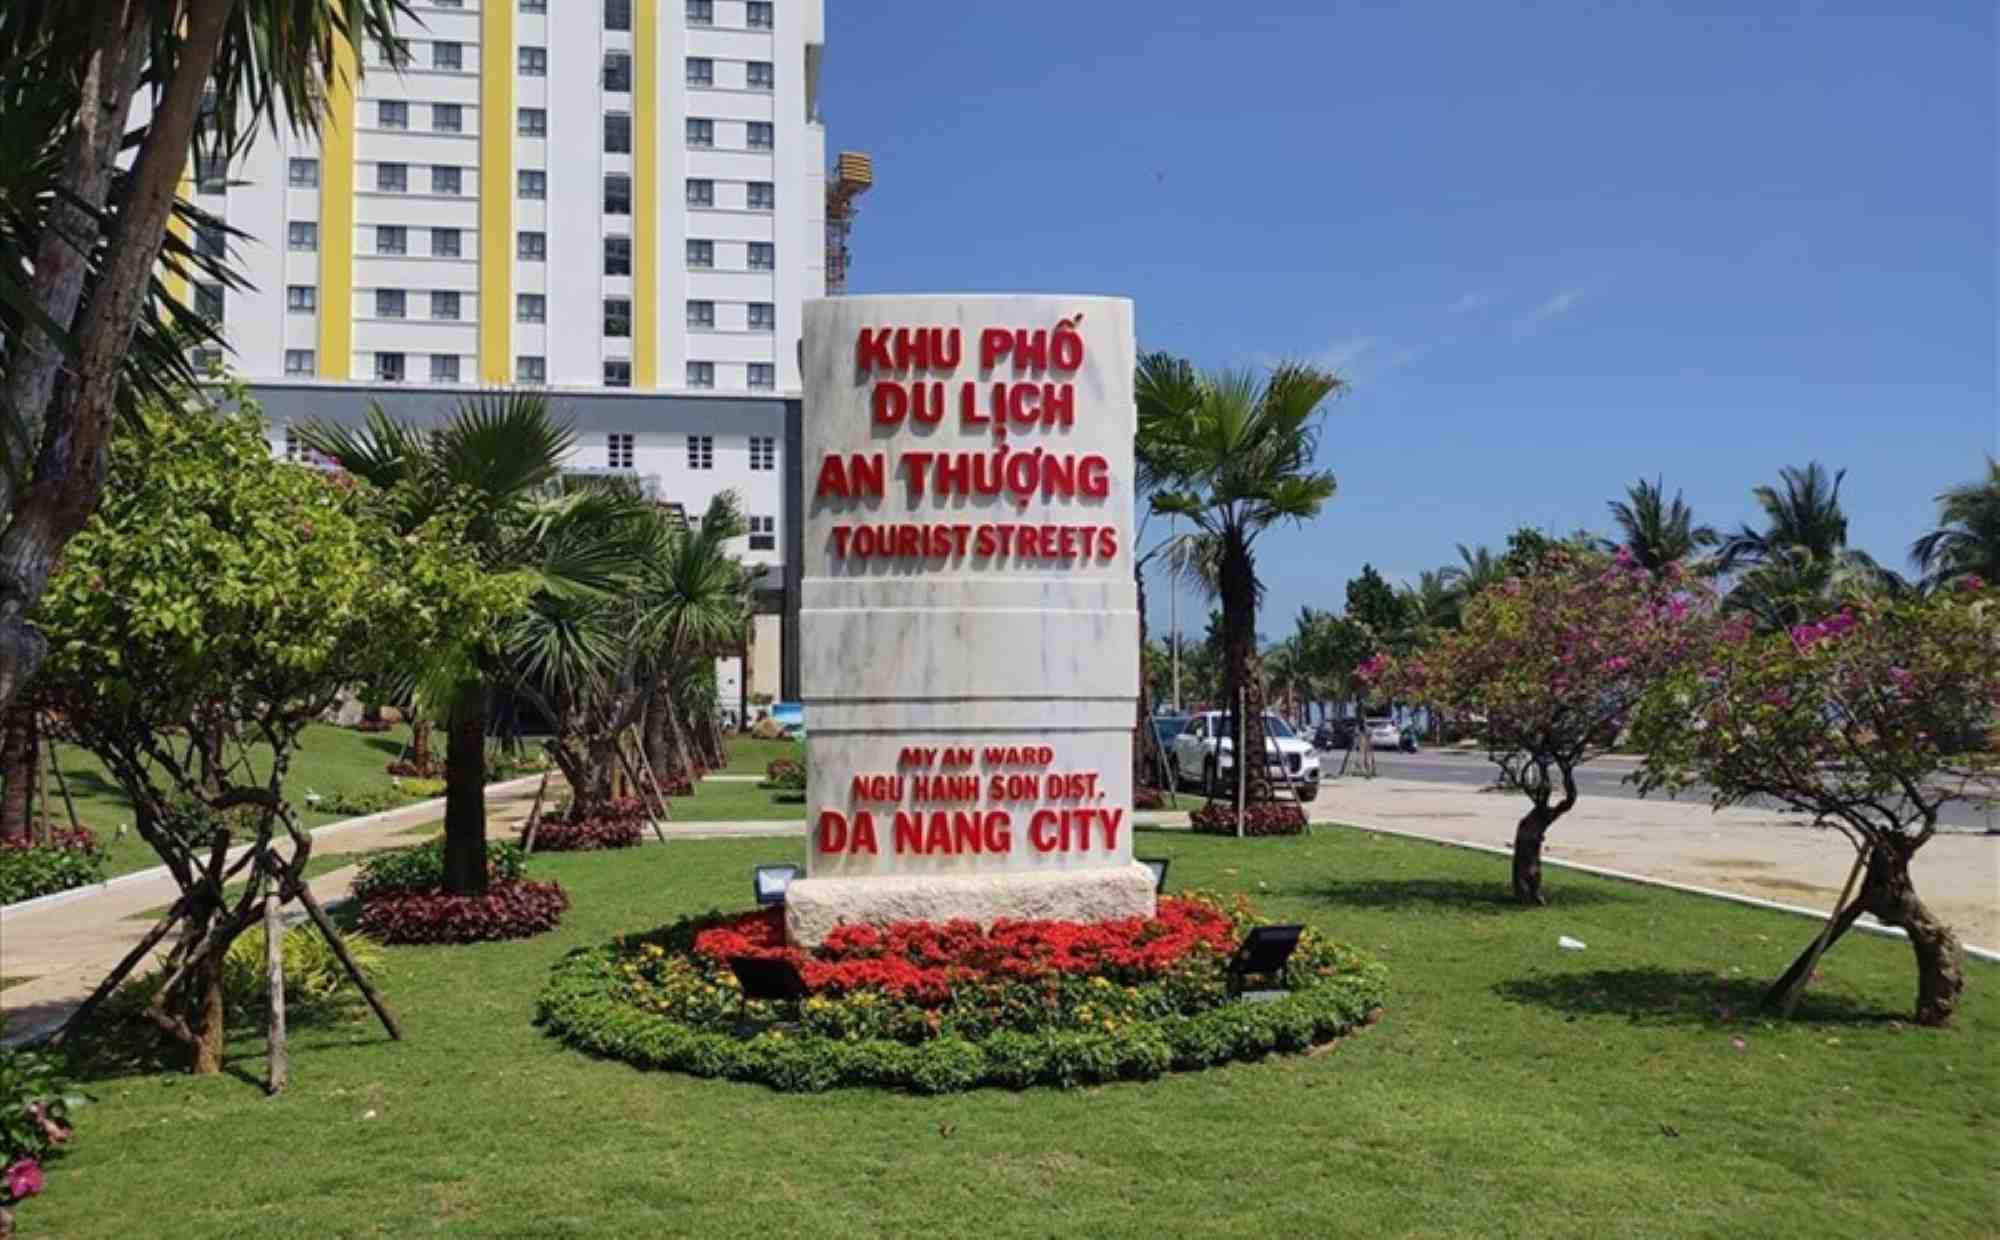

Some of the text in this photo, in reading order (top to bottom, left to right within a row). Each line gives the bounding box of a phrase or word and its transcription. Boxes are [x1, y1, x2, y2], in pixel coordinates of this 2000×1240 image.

[856, 313, 1084, 371] KHU PHỐ
[872, 381, 1075, 438] DU LỊCH
[815, 446, 1110, 508] AN THƯỢNG
[831, 525, 1118, 560] TOURIST STREETS
[899, 746, 1053, 766] MY AN WARD
[851, 773, 1106, 801] NGU HANH SON DIST.
[818, 808, 1123, 855] DA NANG CITY
